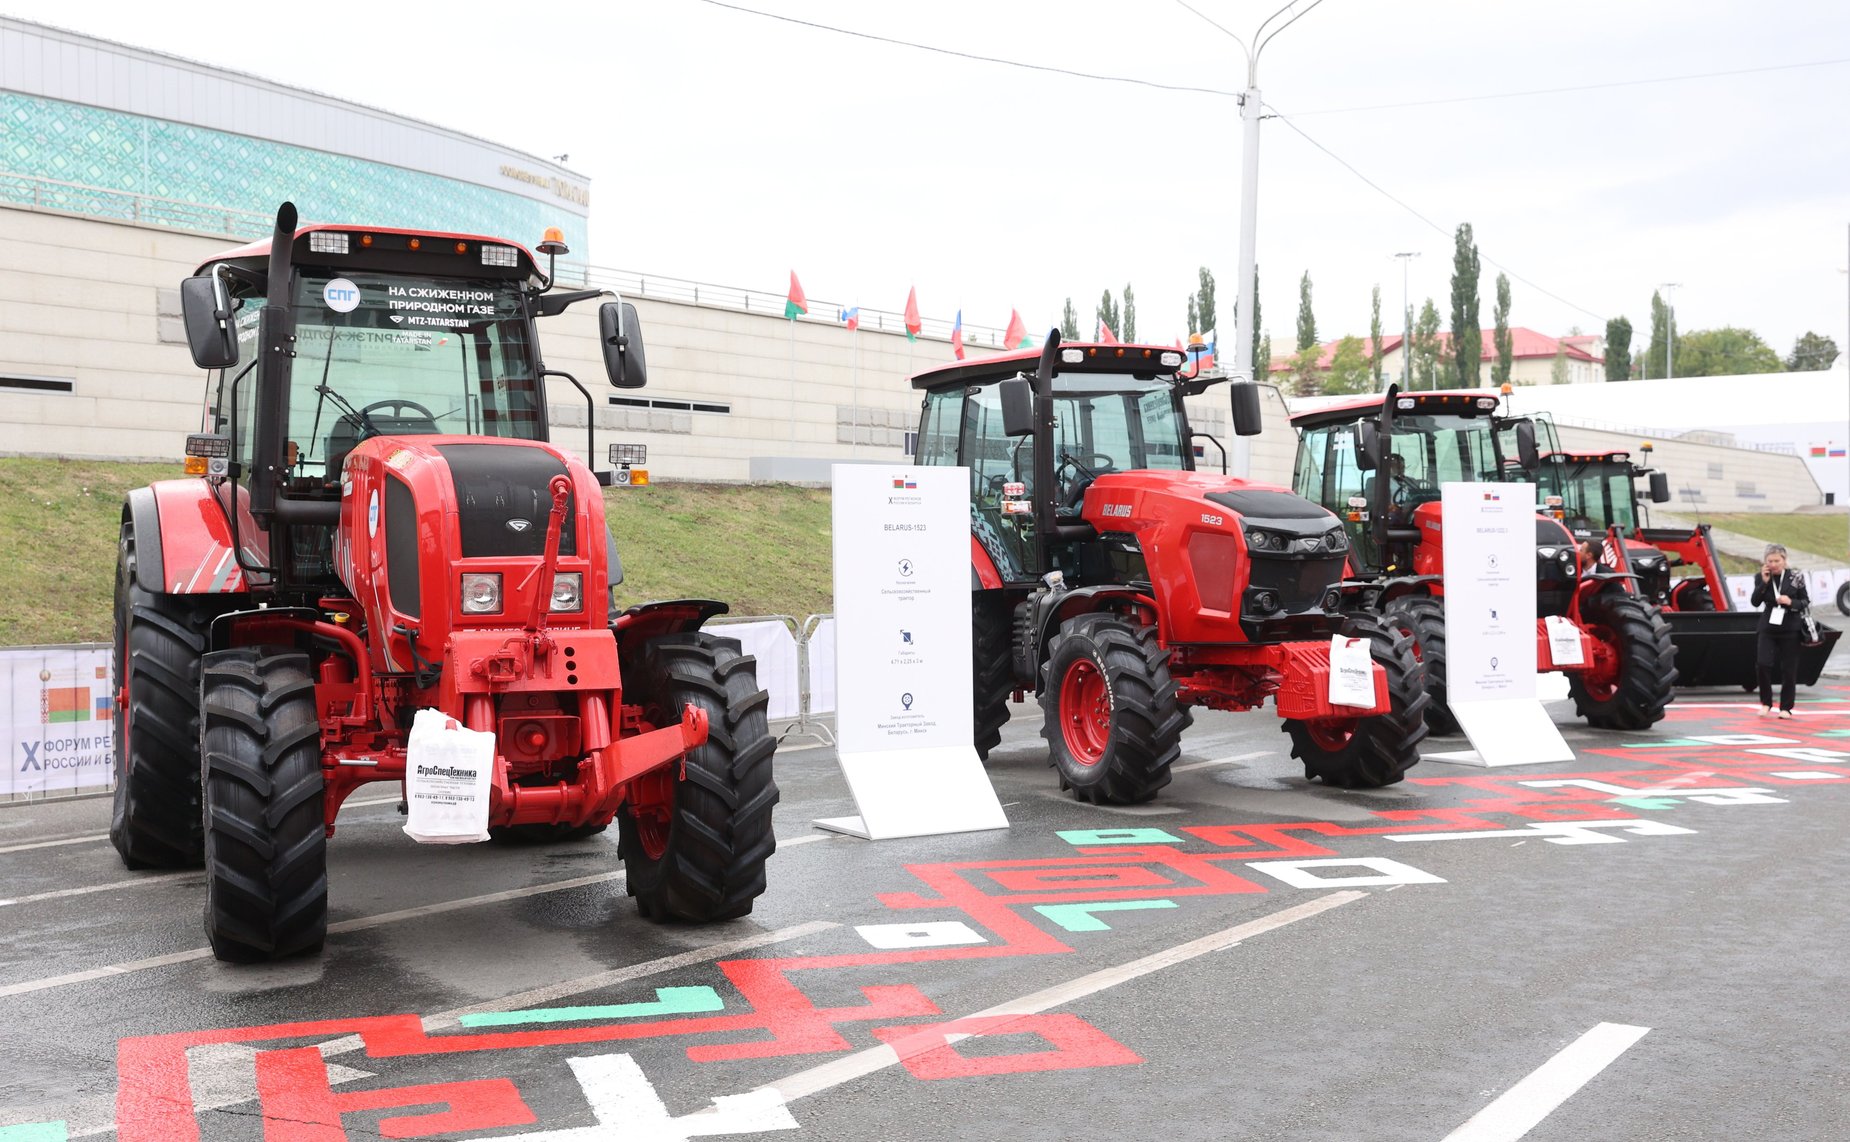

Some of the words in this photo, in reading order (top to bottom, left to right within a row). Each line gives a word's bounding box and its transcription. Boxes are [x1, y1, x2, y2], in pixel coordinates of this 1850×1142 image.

[328, 288, 356, 302] СПГ
[388, 286, 407, 297] НА
[408, 287, 494, 302] СЖИЖЕННОМ
[389, 300, 465, 314] ПРИРОДНОМ
[467, 304, 495, 315] ГАЗЕ
[408, 316, 469, 328] MTZ-TATARSTAN
[392, 336, 432, 345] TATARSTAN
[1102, 503, 1132, 518] BELARUS
[1201, 513, 1223, 526] 1523
[884, 523, 927, 532] BELARUS-1523
[44, 737, 91, 752] ФОРУМ
[95, 736, 112, 749] РЕ
[20, 741, 41, 772] X
[44, 755, 92, 770] РОССИИ
[94, 755, 101, 766] И
[104, 753, 112, 765] Б
[417, 764, 477, 778] АгроСпецТехника
